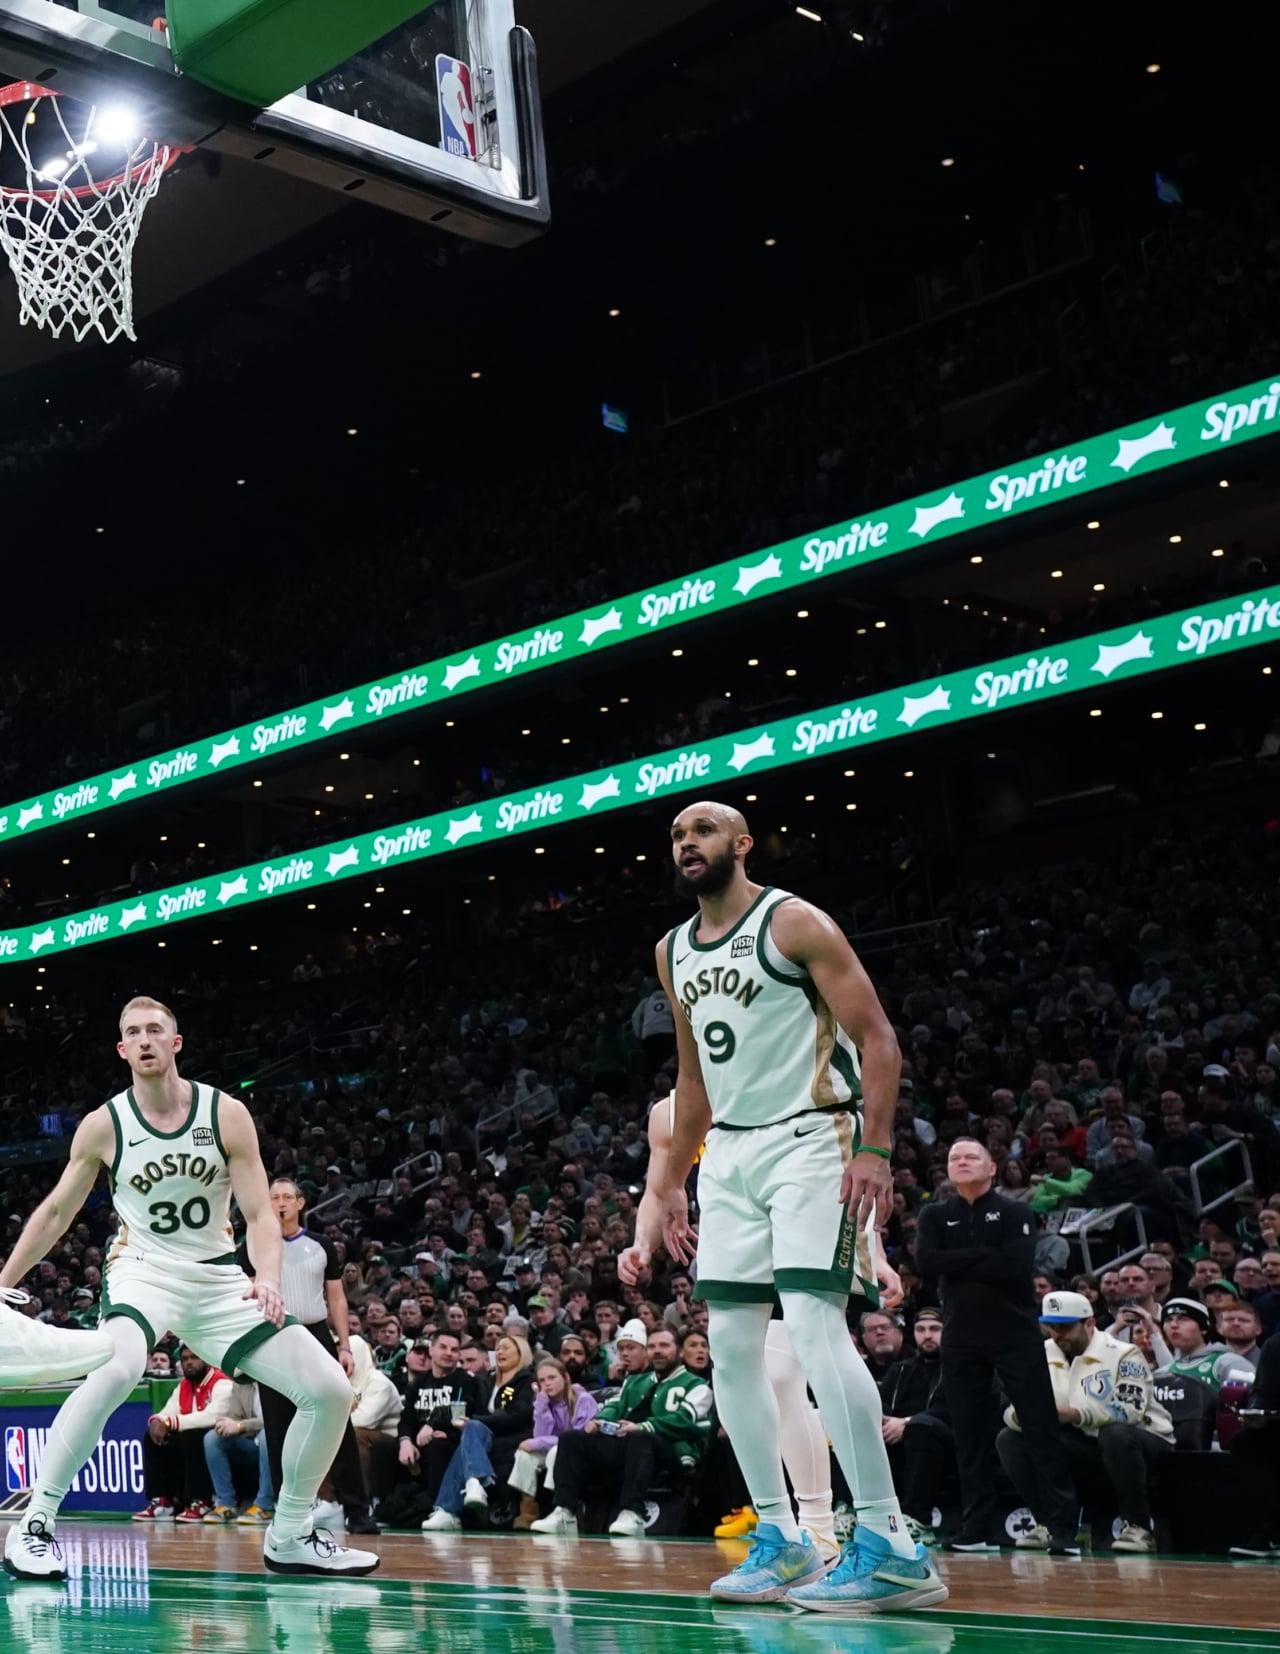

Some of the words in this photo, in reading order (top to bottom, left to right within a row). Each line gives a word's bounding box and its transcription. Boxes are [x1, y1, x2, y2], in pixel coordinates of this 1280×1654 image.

[447, 135, 466, 154] NBA
[52, 785, 98, 818] Sprite
[147, 752, 197, 787] Sprite
[251, 715, 306, 752] Sprite
[366, 675, 428, 715] Sprite
[495, 630, 563, 673] Sprite
[638, 579, 715, 626] Sprite
[800, 522, 888, 572] Sprite
[986, 456, 1086, 511] Sprite
[1201, 383, 1280, 441] Spri
[64, 914, 109, 944] Sprite
[157, 888, 206, 920] Sprite
[259, 859, 313, 893] Sprite
[372, 827, 431, 864] Sprite
[496, 792, 563, 831] Sprite
[636, 752, 710, 795] Sprite
[793, 707, 878, 754] Sprite
[972, 657, 1068, 707] Sprite
[732, 947, 753, 957] PRINT
[733, 937, 754, 948] VISTA
[704, 1020, 736, 1064] 9
[192, 1128, 212, 1138] VISTA
[193, 1138, 213, 1146] PRINT
[128, 1153, 220, 1196] BOSTON
[148, 1195, 211, 1235] 30
[839, 1223, 853, 1269] CELTICS
[665, 1386, 686, 1412] C
